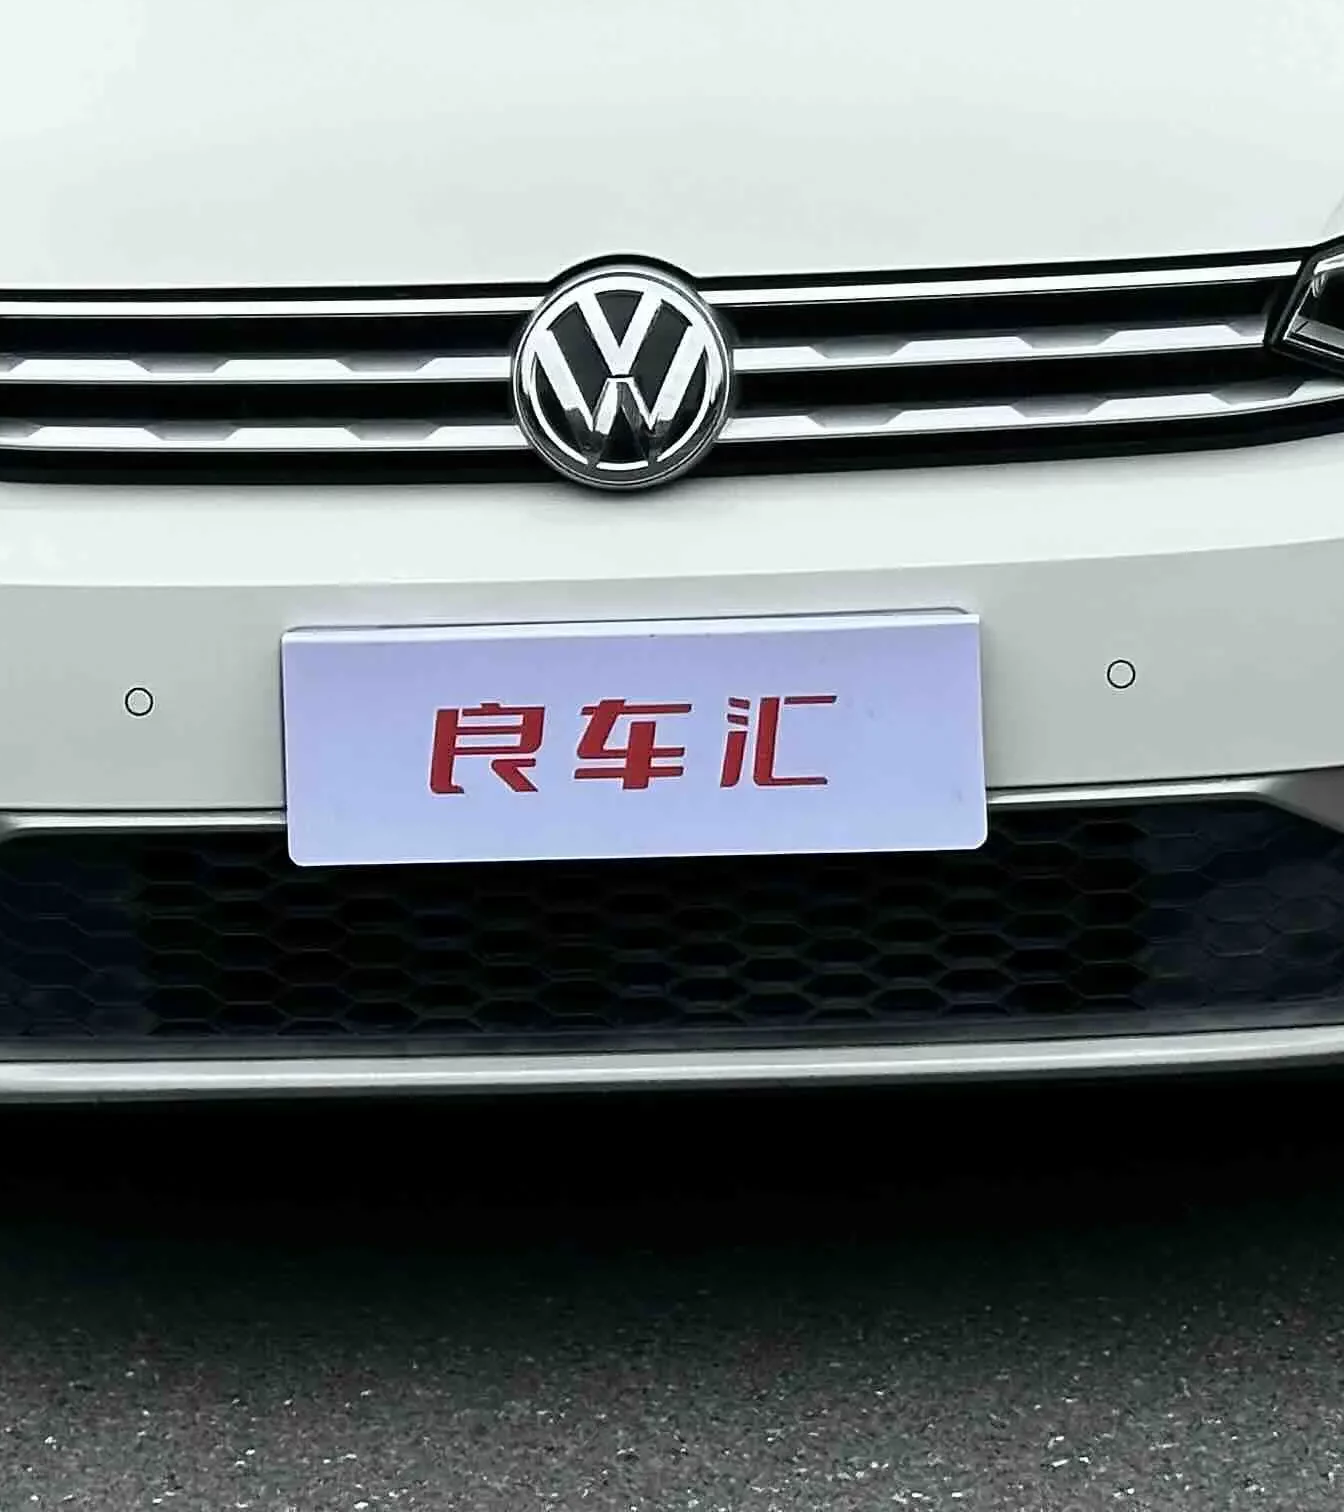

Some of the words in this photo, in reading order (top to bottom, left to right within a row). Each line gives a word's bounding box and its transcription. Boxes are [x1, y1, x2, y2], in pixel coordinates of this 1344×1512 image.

[525, 285, 717, 472] VW
[429, 695, 838, 795] 良车汇
